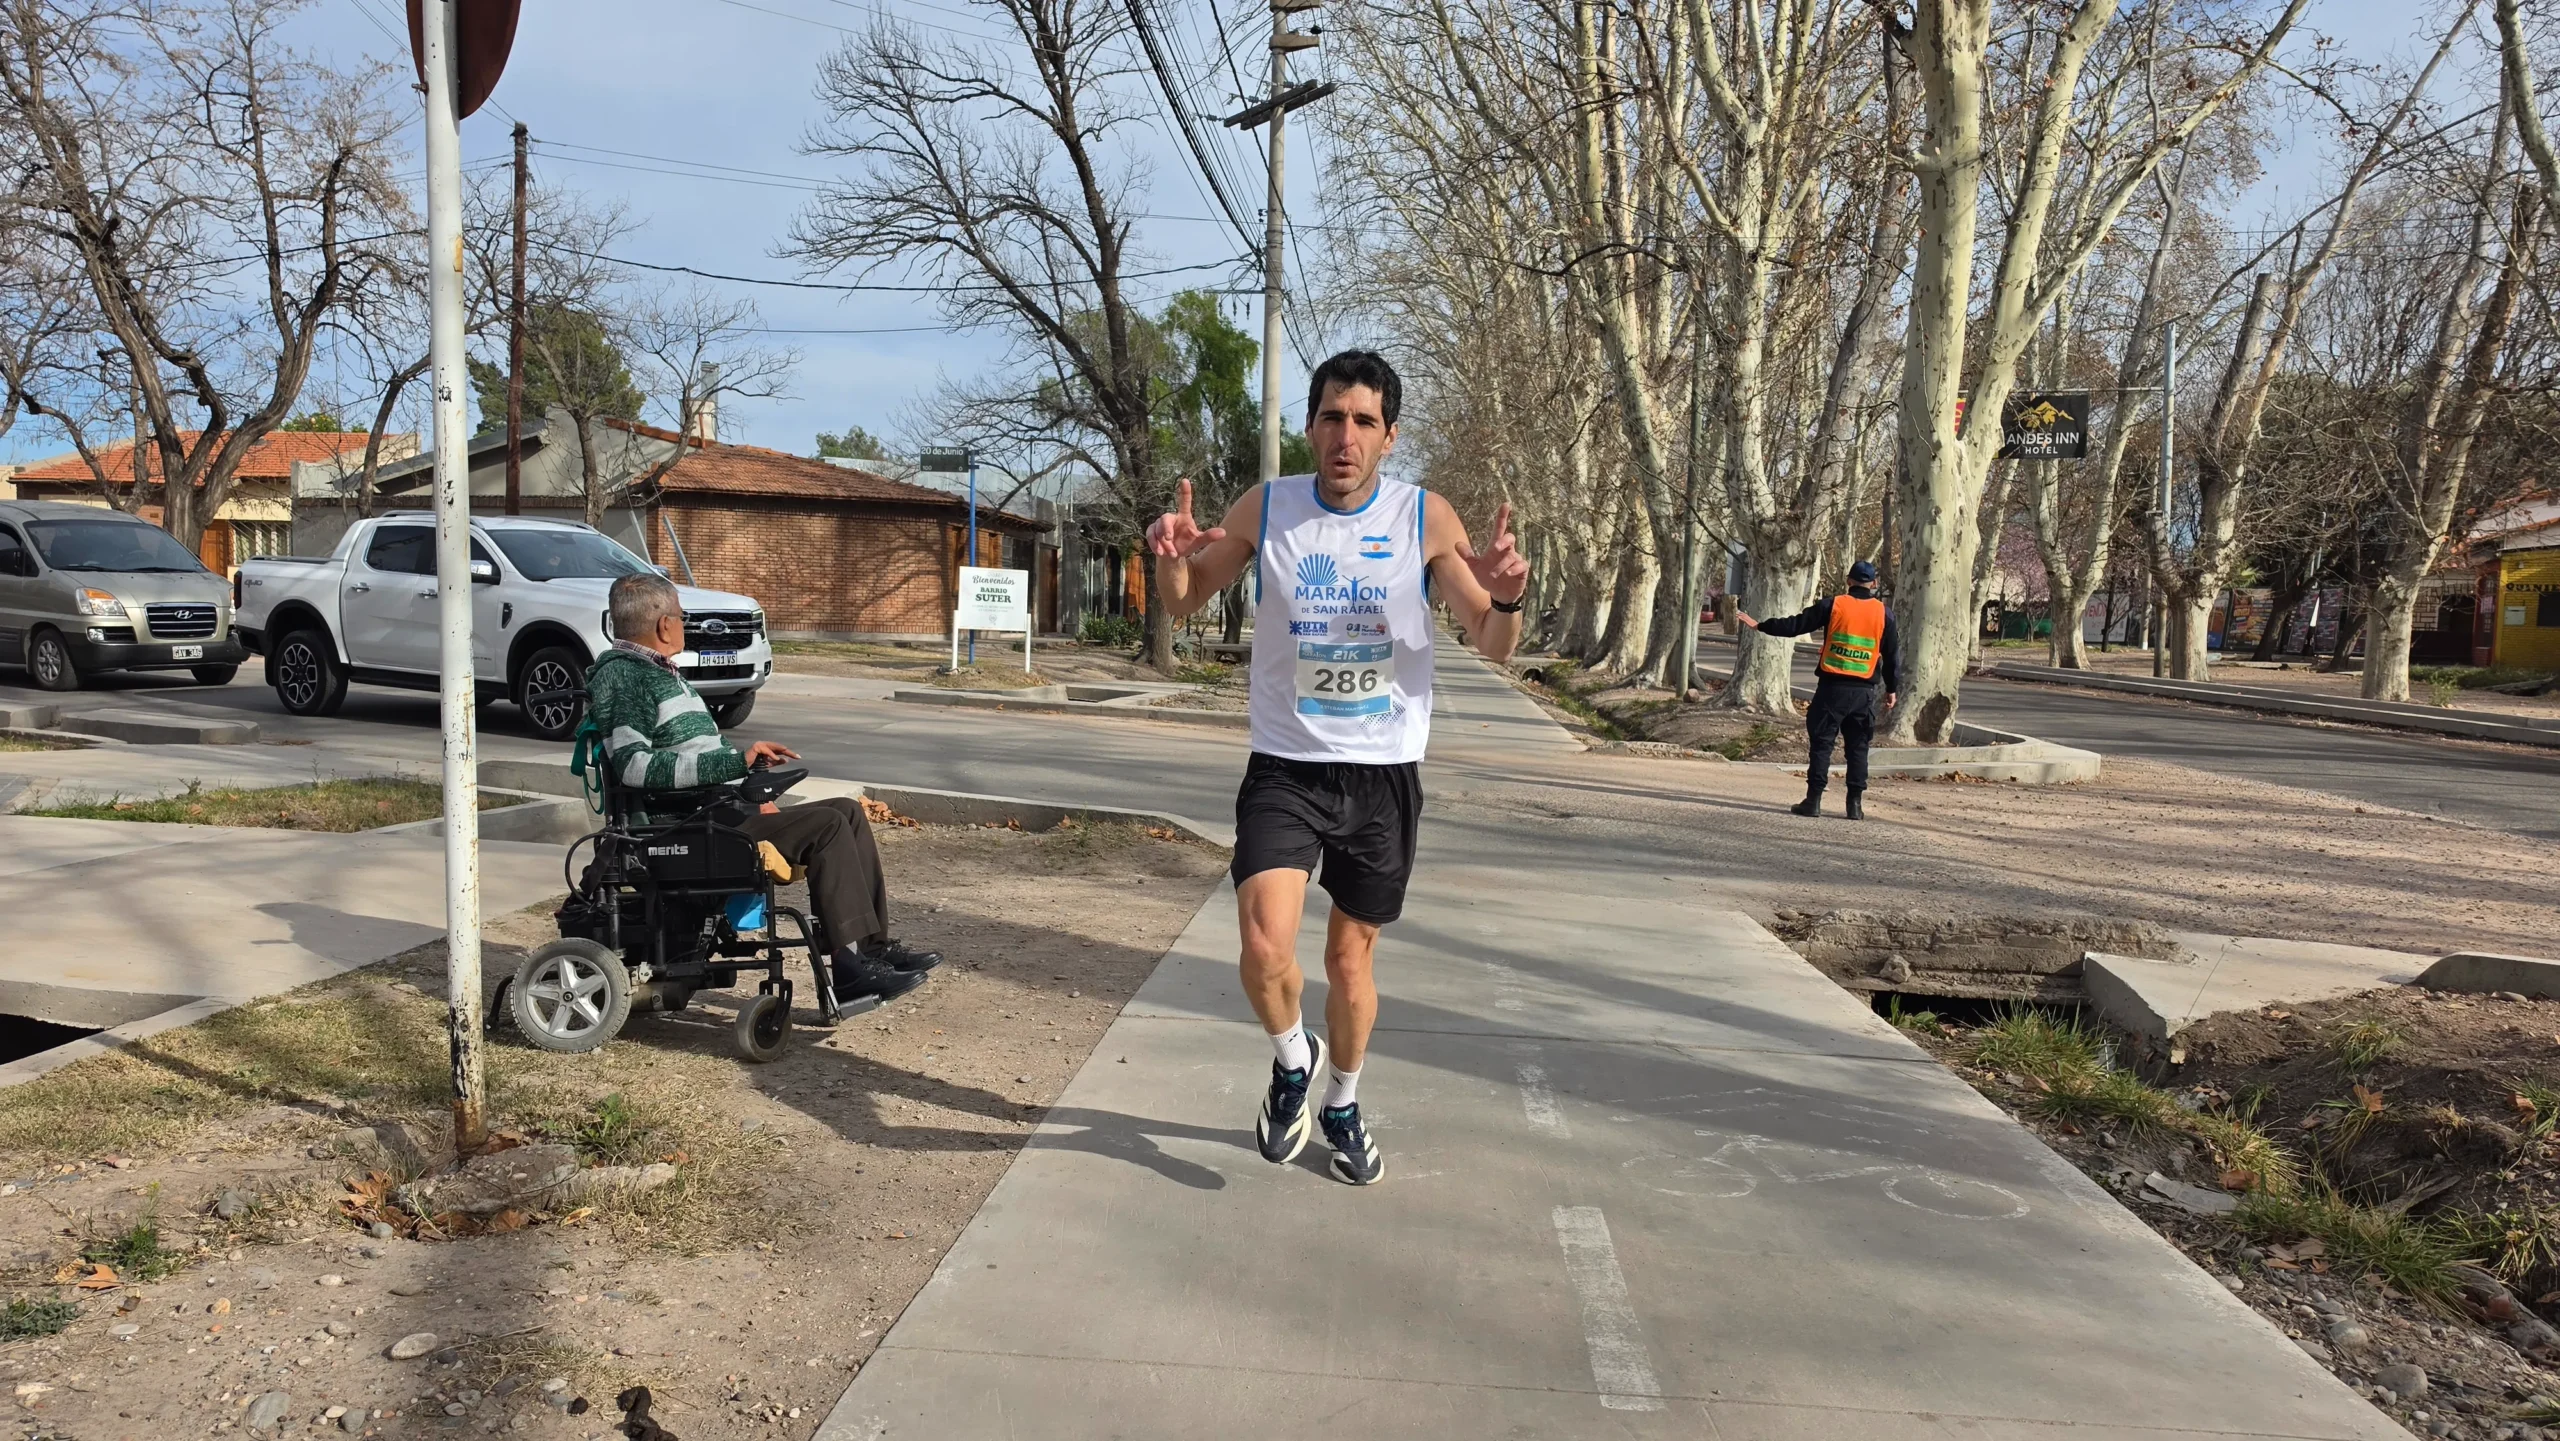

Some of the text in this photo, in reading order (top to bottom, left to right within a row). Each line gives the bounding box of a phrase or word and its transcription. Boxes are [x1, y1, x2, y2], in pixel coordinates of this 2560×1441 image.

[2006, 432, 2080, 445] ANDES INN
[921, 447, 964, 456] 20 de Junio
[2025, 446, 2058, 455] HOTEL
[972, 575, 1015, 585] Bienvenidos
[975, 594, 1012, 603] SUTER
[1313, 605, 1338, 614] SAN
[1341, 605, 1385, 614] RAFAEL
[1303, 622, 1328, 630] UTN
[1333, 650, 1360, 660] 21K
[1830, 644, 1870, 660] POLICIA
[702, 655, 736, 665] AH 411 VS
[1314, 668, 1378, 694] 286
